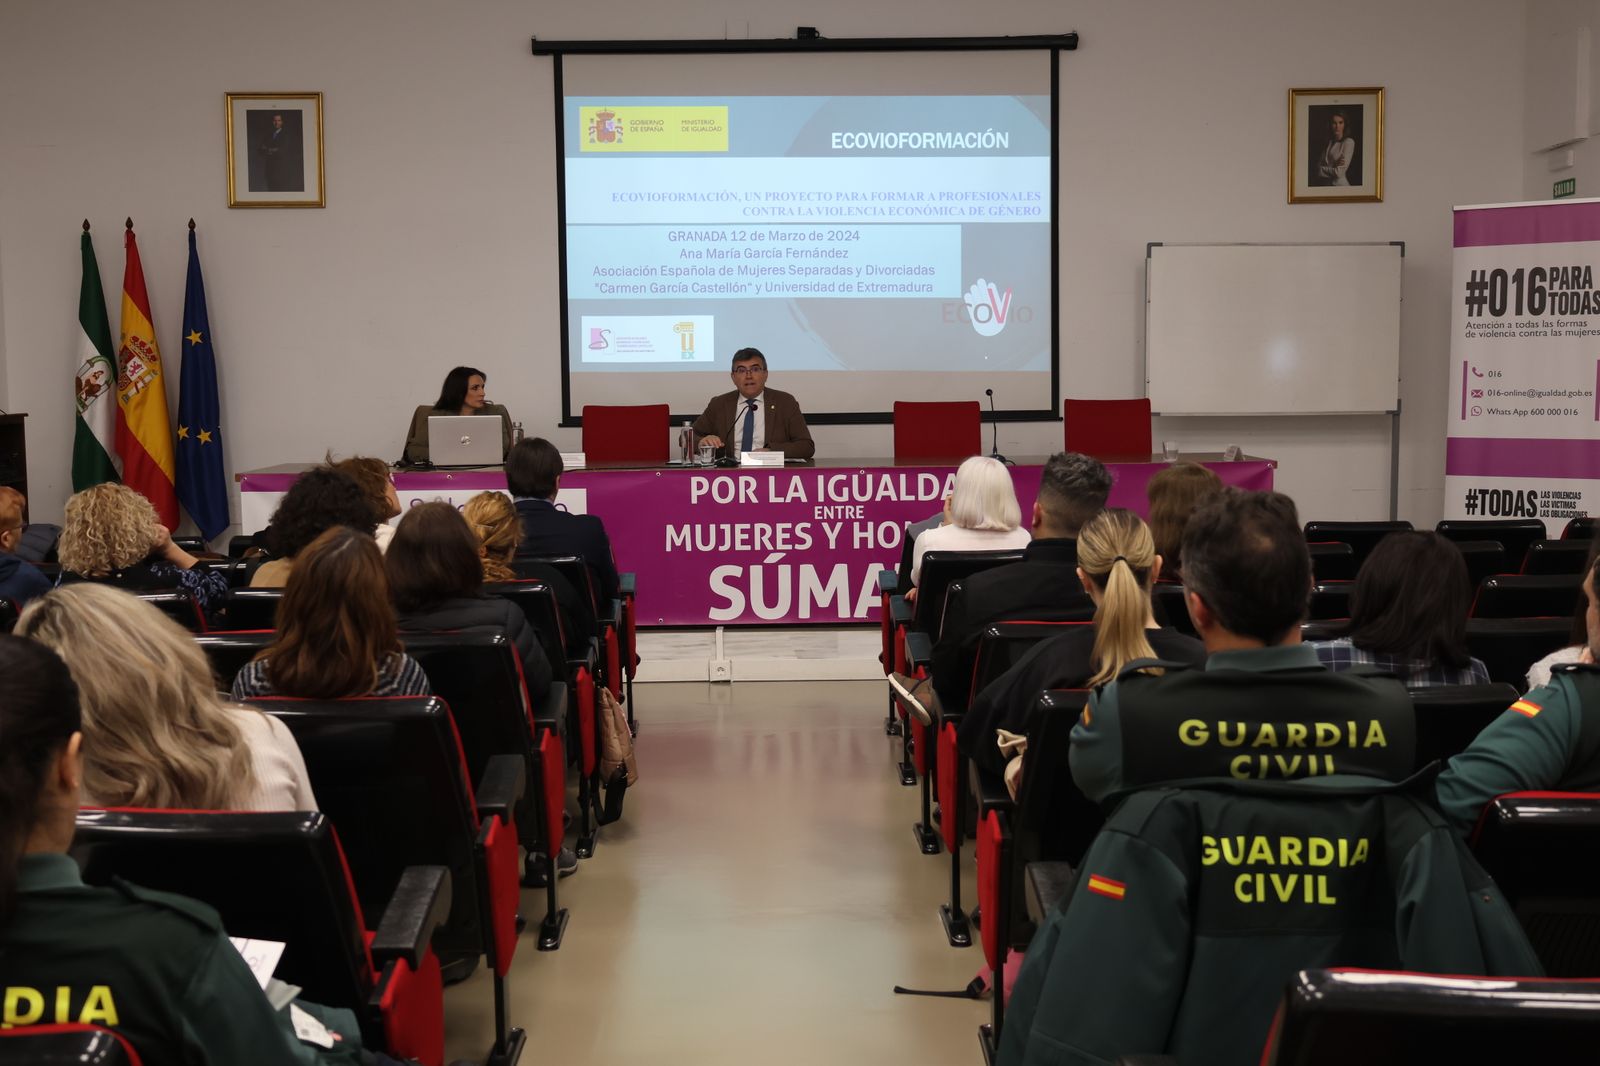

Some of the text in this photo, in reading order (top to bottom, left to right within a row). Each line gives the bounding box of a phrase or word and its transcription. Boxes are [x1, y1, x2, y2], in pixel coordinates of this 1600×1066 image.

[831, 128, 1009, 149] ECOVIOFORMACIÓN
[1554, 180, 1574, 196] SALIDA
[612, 189, 1041, 203] ECOVIOFORMACIÓN, UN PROYECTO PARA FORMAR A PROFESIONALES
[742, 203, 1041, 217] CONTRA LA VIOLENCIA ECONÓMICA DE GÉNERO
[668, 230, 861, 242] GRANADA 12 de Marzo de 2024
[680, 247, 849, 259] Ana María García Fernández
[592, 264, 936, 279] Asociación Española de Mujeres Separadas y Divorciadas
[649, 281, 688, 293] García
[755, 284, 762, 294] y
[765, 281, 836, 293] Universidad
[838, 281, 854, 292] de
[857, 281, 934, 292] Extremadura
[1465, 265, 1593, 317] #016 PARA
[1548, 290, 1600, 316] TODAS
[1465, 321, 1505, 329] Atención
[1515, 320, 1539, 328] todas
[1542, 320, 1554, 328] las
[1556, 319, 1588, 328] formas
[1465, 328, 1600, 339] de violencia contra las mujeres
[1488, 370, 1503, 378] 016
[1487, 388, 1593, 399] 016-online@igualdad.gob.es
[1487, 408, 1579, 417] Whats App 600 000 016
[690, 475, 759, 504] POR
[768, 475, 808, 503] LA
[1465, 488, 1582, 518] #TODAS LAS VIOLENCIAS
[1540, 500, 1551, 508] LAS
[814, 505, 865, 520] ENTRE
[1540, 509, 1550, 518] LAS
[665, 521, 912, 552] MUJERES Y HO
[708, 552, 900, 621] SÚMA
[1178, 719, 1388, 748] GUARDIA
[1201, 836, 1370, 868] GUARDIA
[1234, 873, 1337, 904] CIVIL
